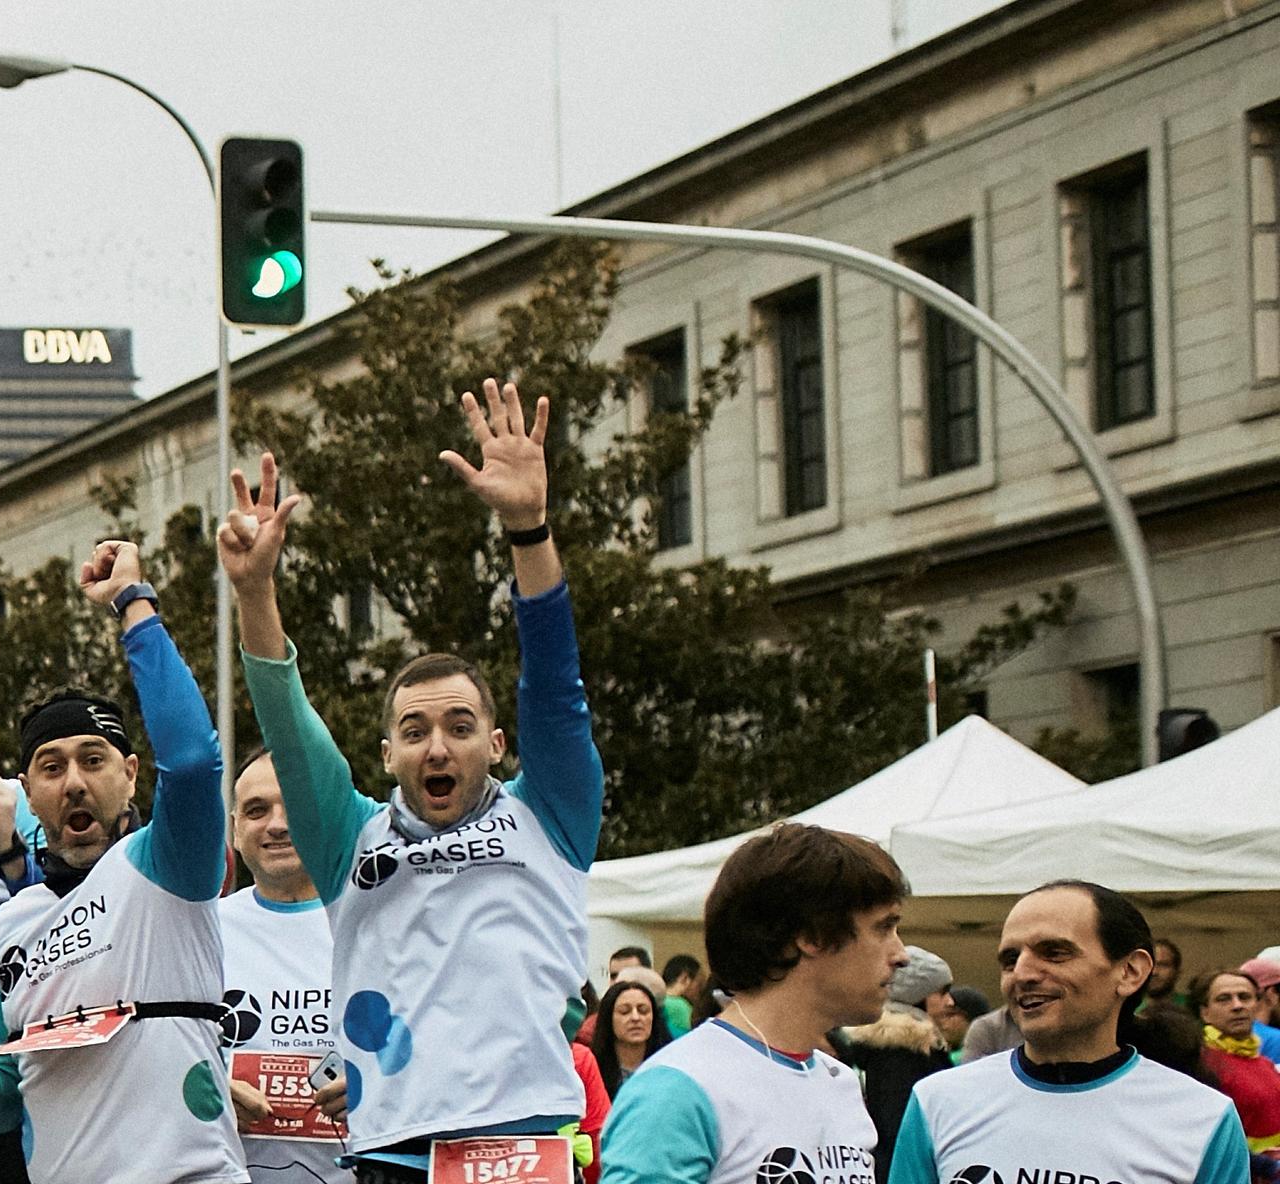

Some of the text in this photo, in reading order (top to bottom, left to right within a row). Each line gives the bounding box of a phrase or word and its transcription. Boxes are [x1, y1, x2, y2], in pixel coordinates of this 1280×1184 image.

[407, 838, 505, 866] GASES
[271, 1014, 329, 1035] GAS
[271, 1039, 290, 1048] The
[293, 1038, 314, 1048] Gas
[258, 1074, 317, 1098] 1553
[463, 1154, 542, 1184] 15477
